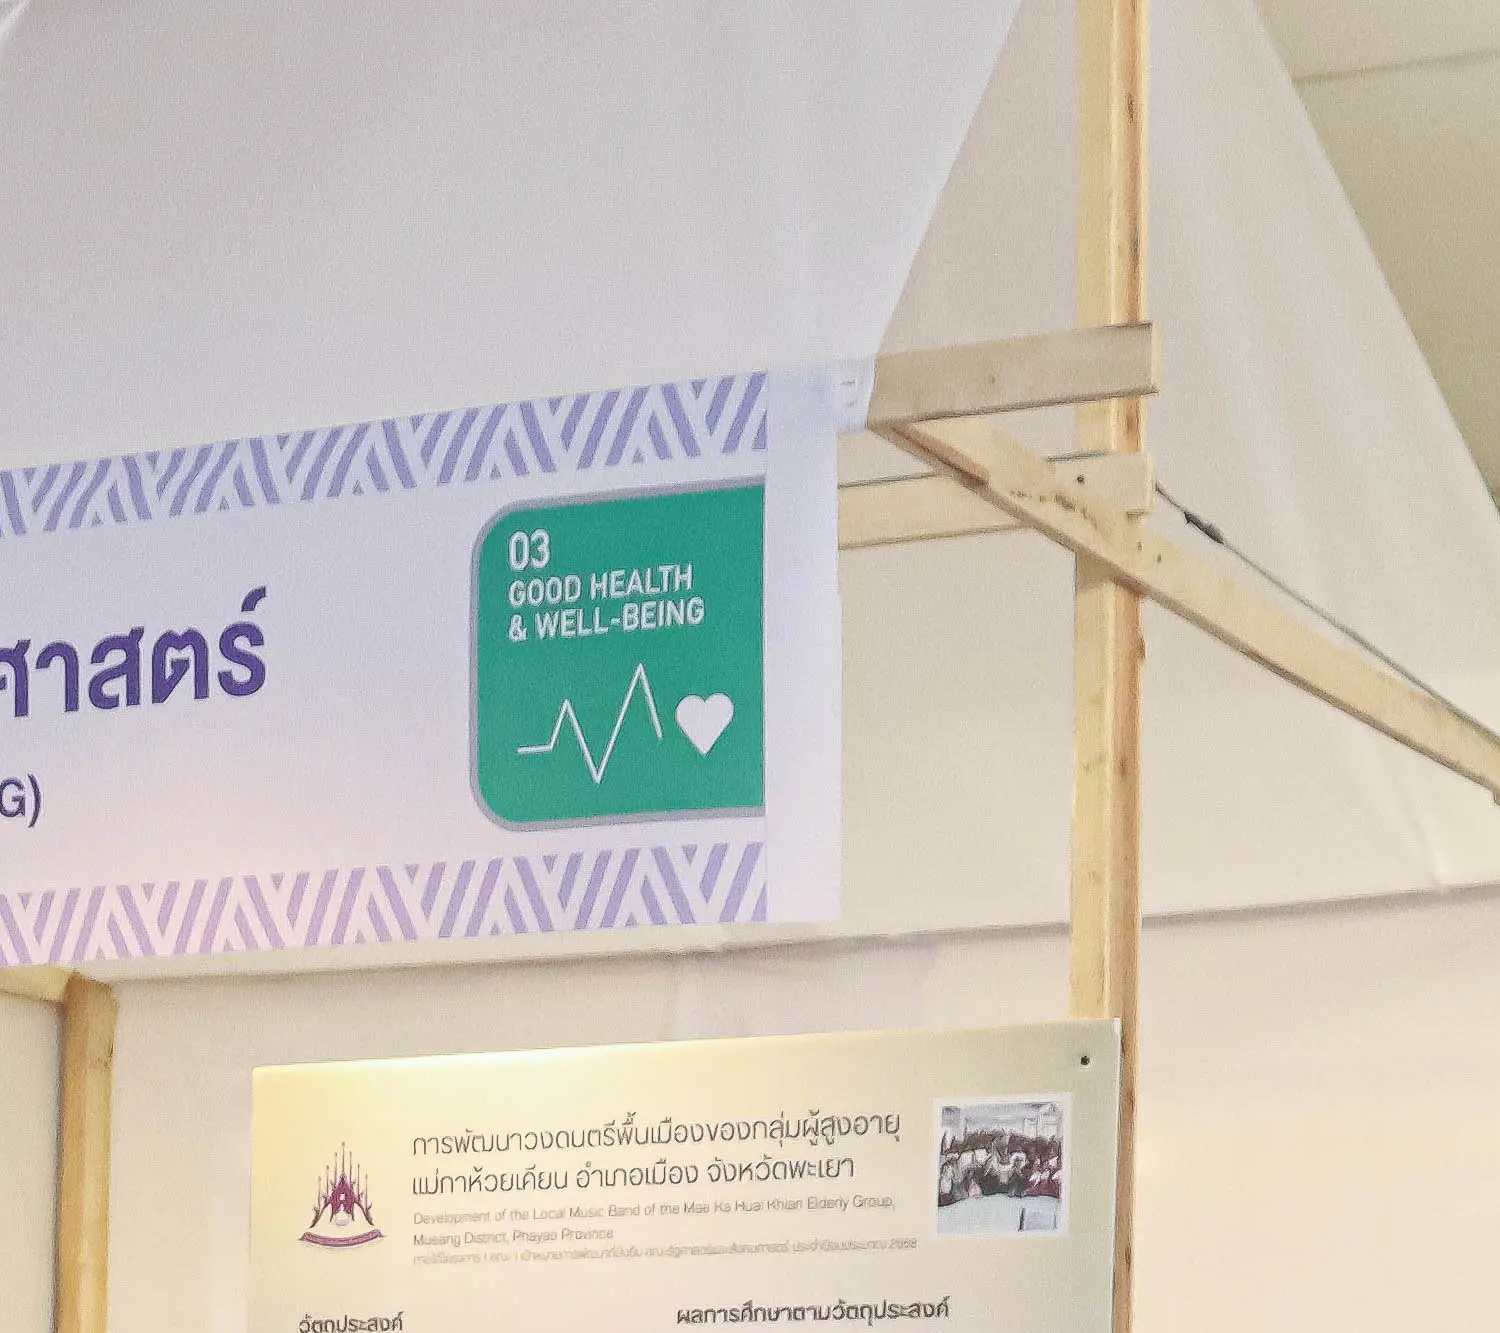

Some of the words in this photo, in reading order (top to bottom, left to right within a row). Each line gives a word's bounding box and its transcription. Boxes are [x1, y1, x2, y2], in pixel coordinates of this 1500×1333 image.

[508, 529, 551, 571] 03
[508, 574, 582, 608] GOOD
[590, 562, 694, 602] HEALTH
[508, 613, 528, 642] &
[534, 596, 706, 640] WELL-BEING
[412, 1110, 900, 1155] การพัฒนาวงดนตรีพื้นเมืองของกลุ่มผู้สูงอายุ
[412, 1164, 568, 1195] แม่กาห้วยเคียน
[576, 1157, 698, 1188] อำเภอเมือง
[707, 1153, 855, 1183] จังหวัดพะเยา
[533, 1207, 566, 1221] Local
[569, 1206, 604, 1219] Music
[608, 1204, 640, 1217] Band
[644, 1203, 657, 1216] of
[677, 1295, 951, 1327] ผลการศึกษาตามวัตถุประสงค์
